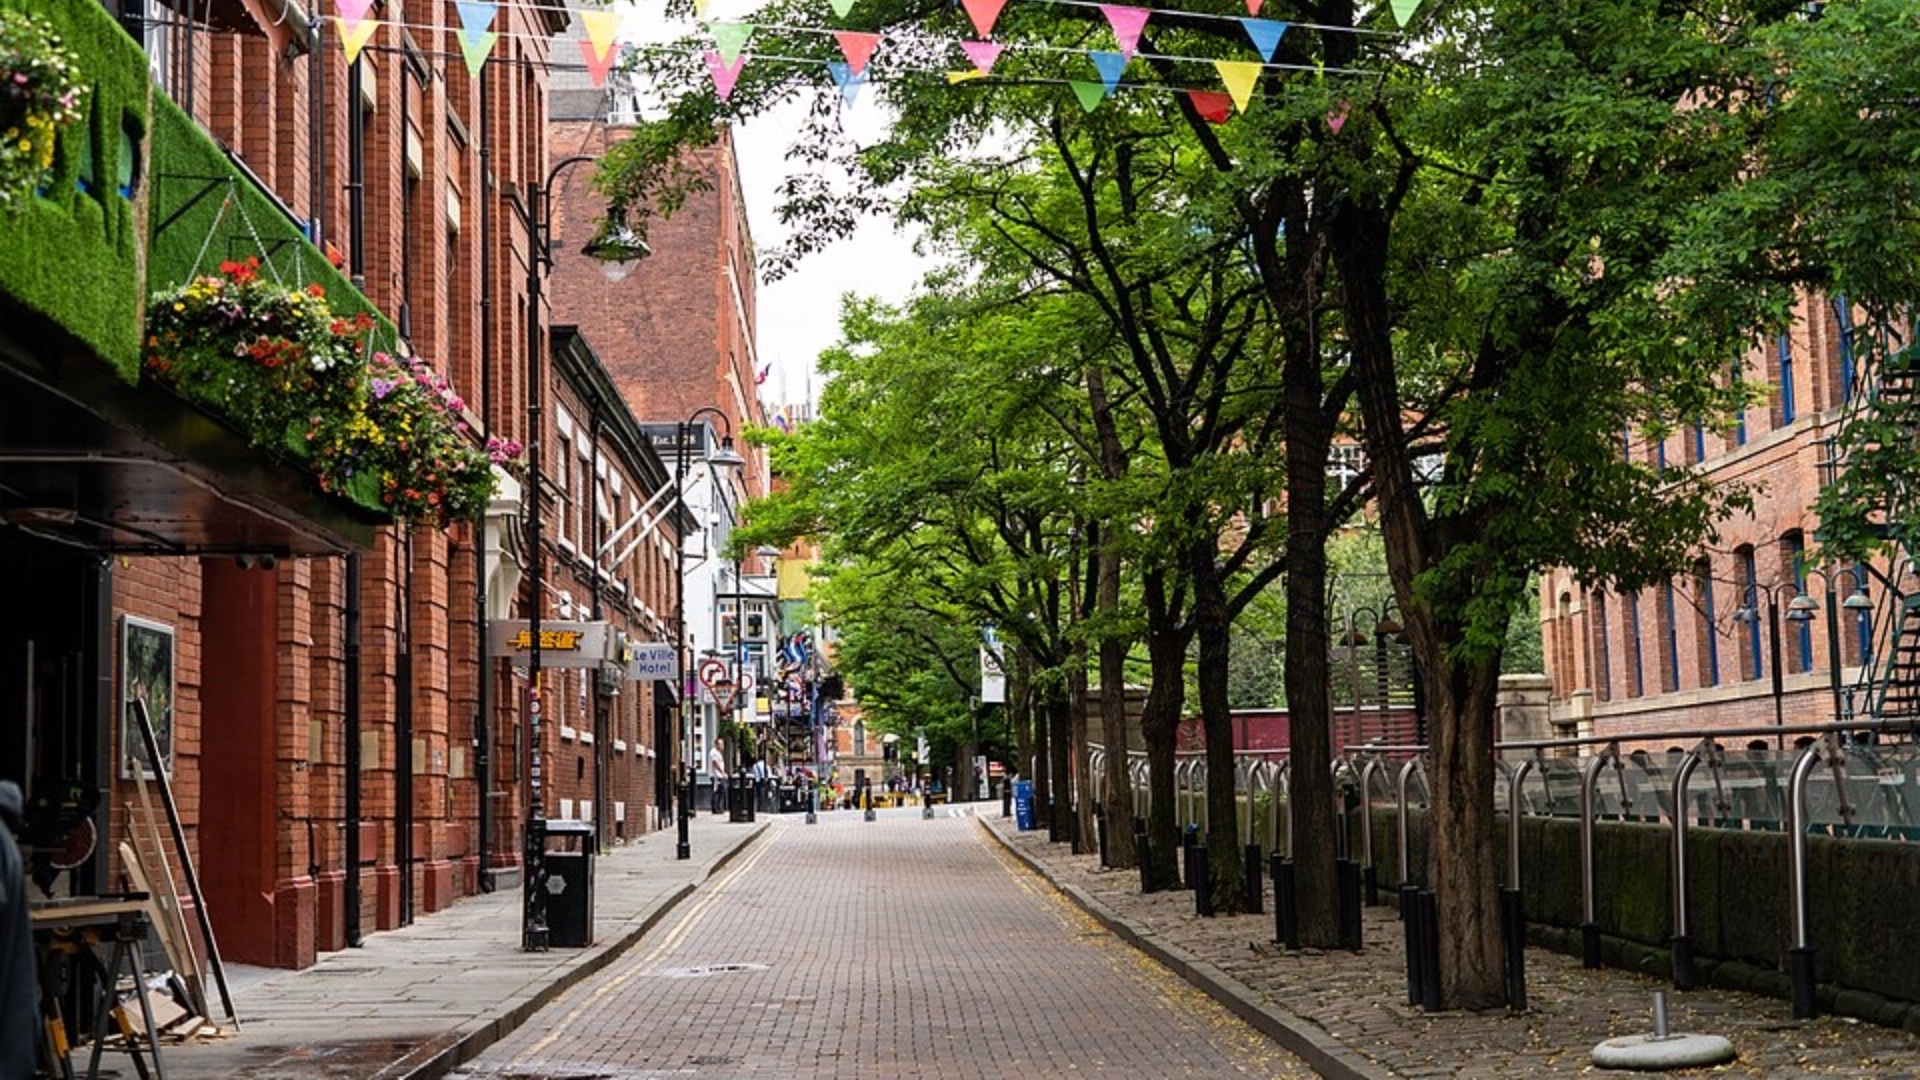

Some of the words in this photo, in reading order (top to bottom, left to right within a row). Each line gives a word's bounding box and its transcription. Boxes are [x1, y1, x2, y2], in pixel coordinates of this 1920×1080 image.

[634, 650, 647, 661] Le
[649, 649, 675, 661] Ville
[639, 662, 671, 674] Hotel
